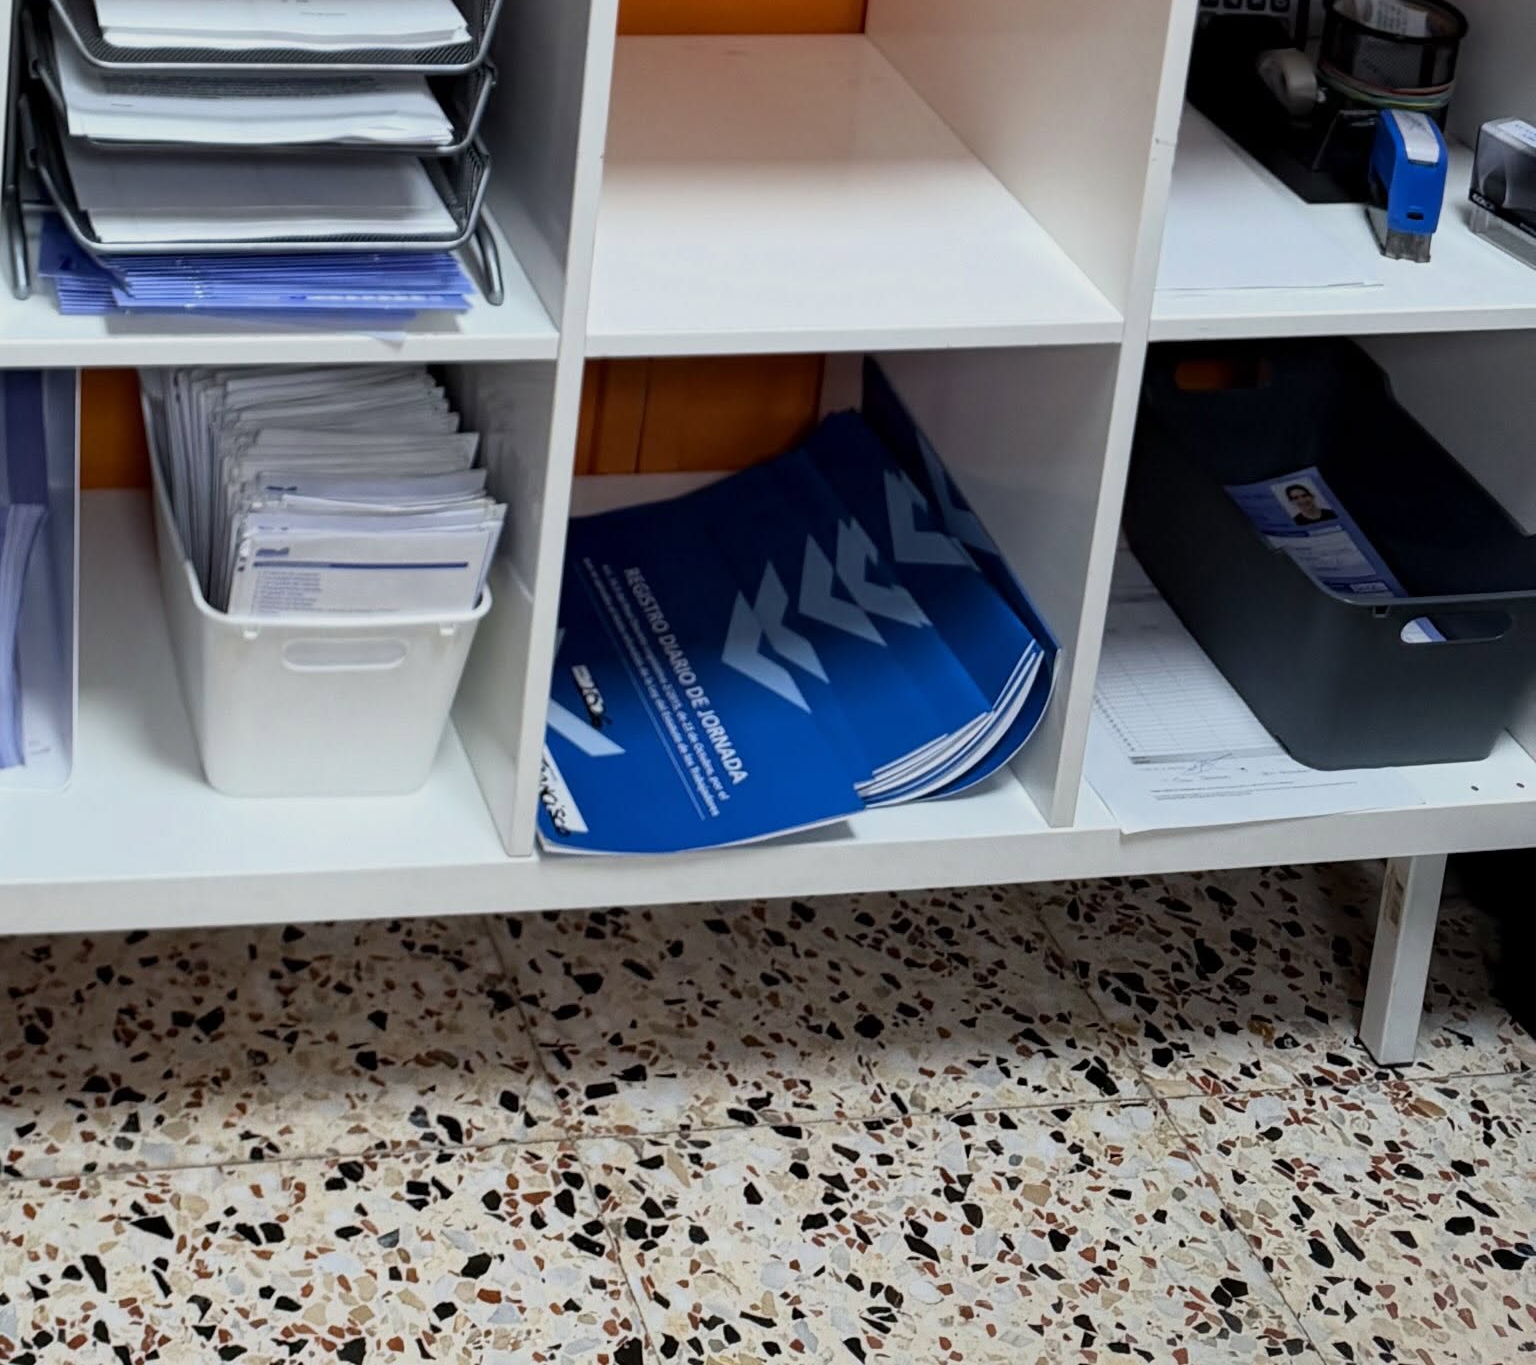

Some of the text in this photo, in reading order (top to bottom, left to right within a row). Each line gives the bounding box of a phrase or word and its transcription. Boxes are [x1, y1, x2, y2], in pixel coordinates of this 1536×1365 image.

[623, 566, 672, 634] REGISTRO
[660, 635, 698, 686] DIARIO
[684, 687, 711, 709] DE
[696, 710, 750, 784] JORNADA
